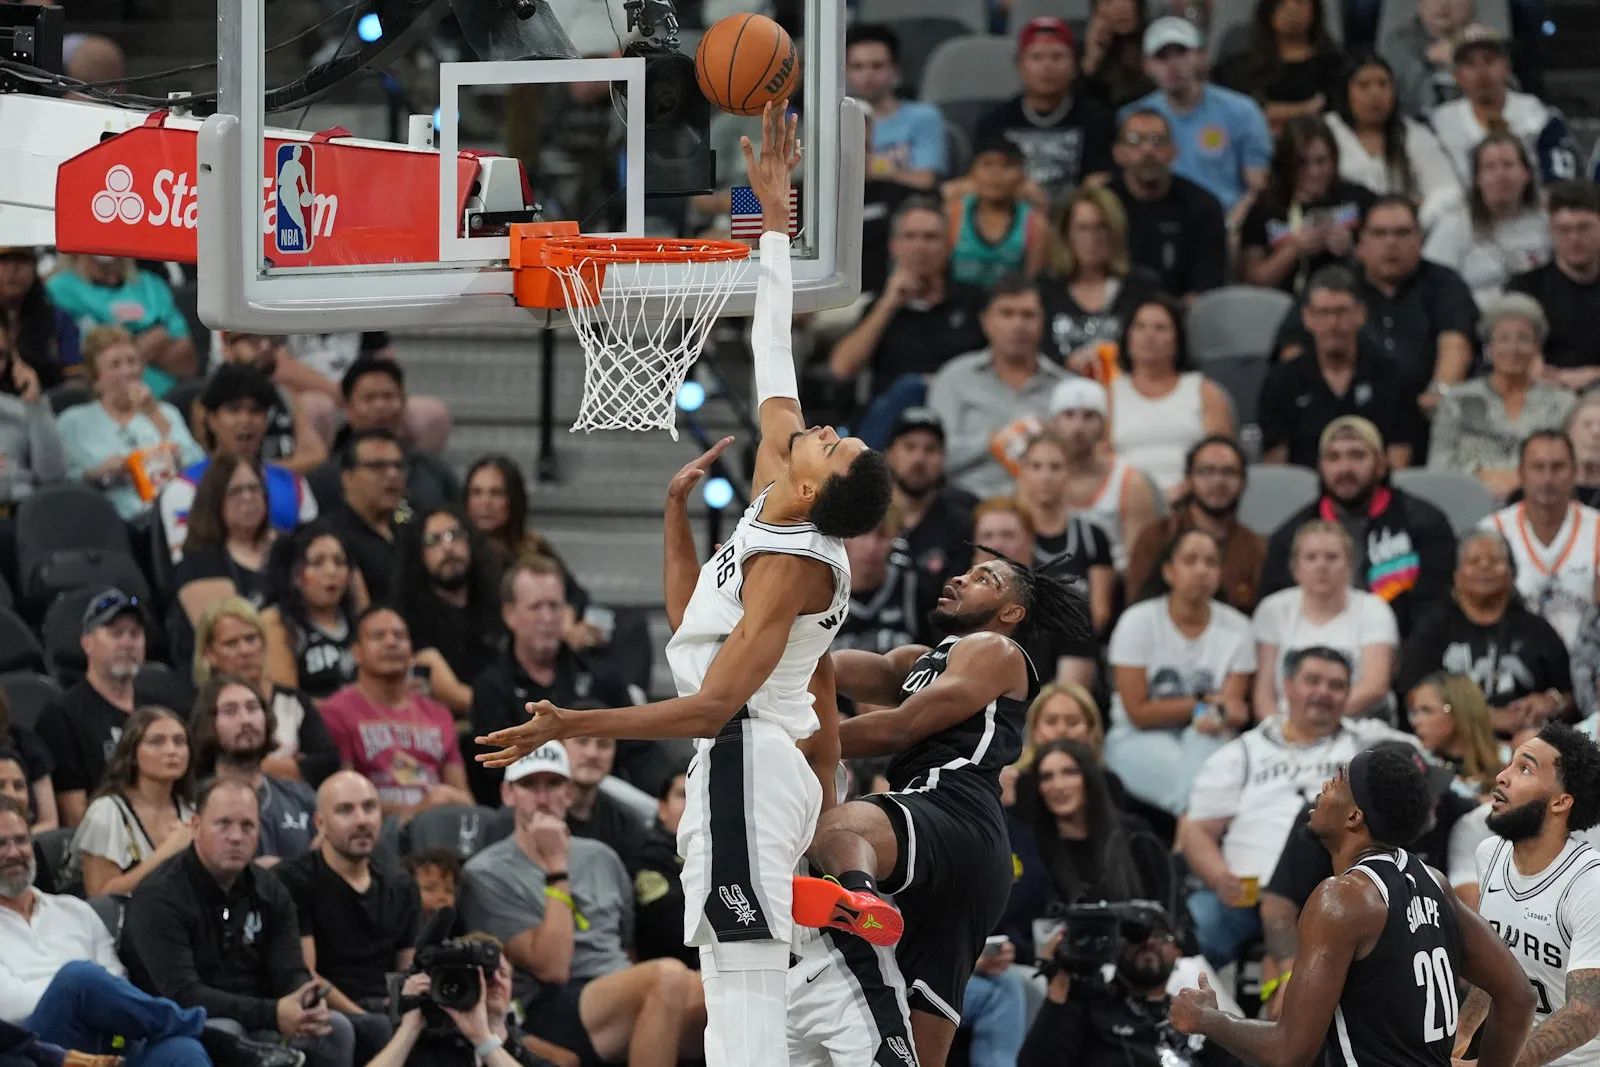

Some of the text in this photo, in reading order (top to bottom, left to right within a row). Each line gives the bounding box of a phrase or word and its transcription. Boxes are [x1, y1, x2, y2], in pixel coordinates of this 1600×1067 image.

[281, 228, 299, 247] NBA
[1527, 911, 1549, 922] LEDGER
[1412, 946, 1459, 1044] 20
